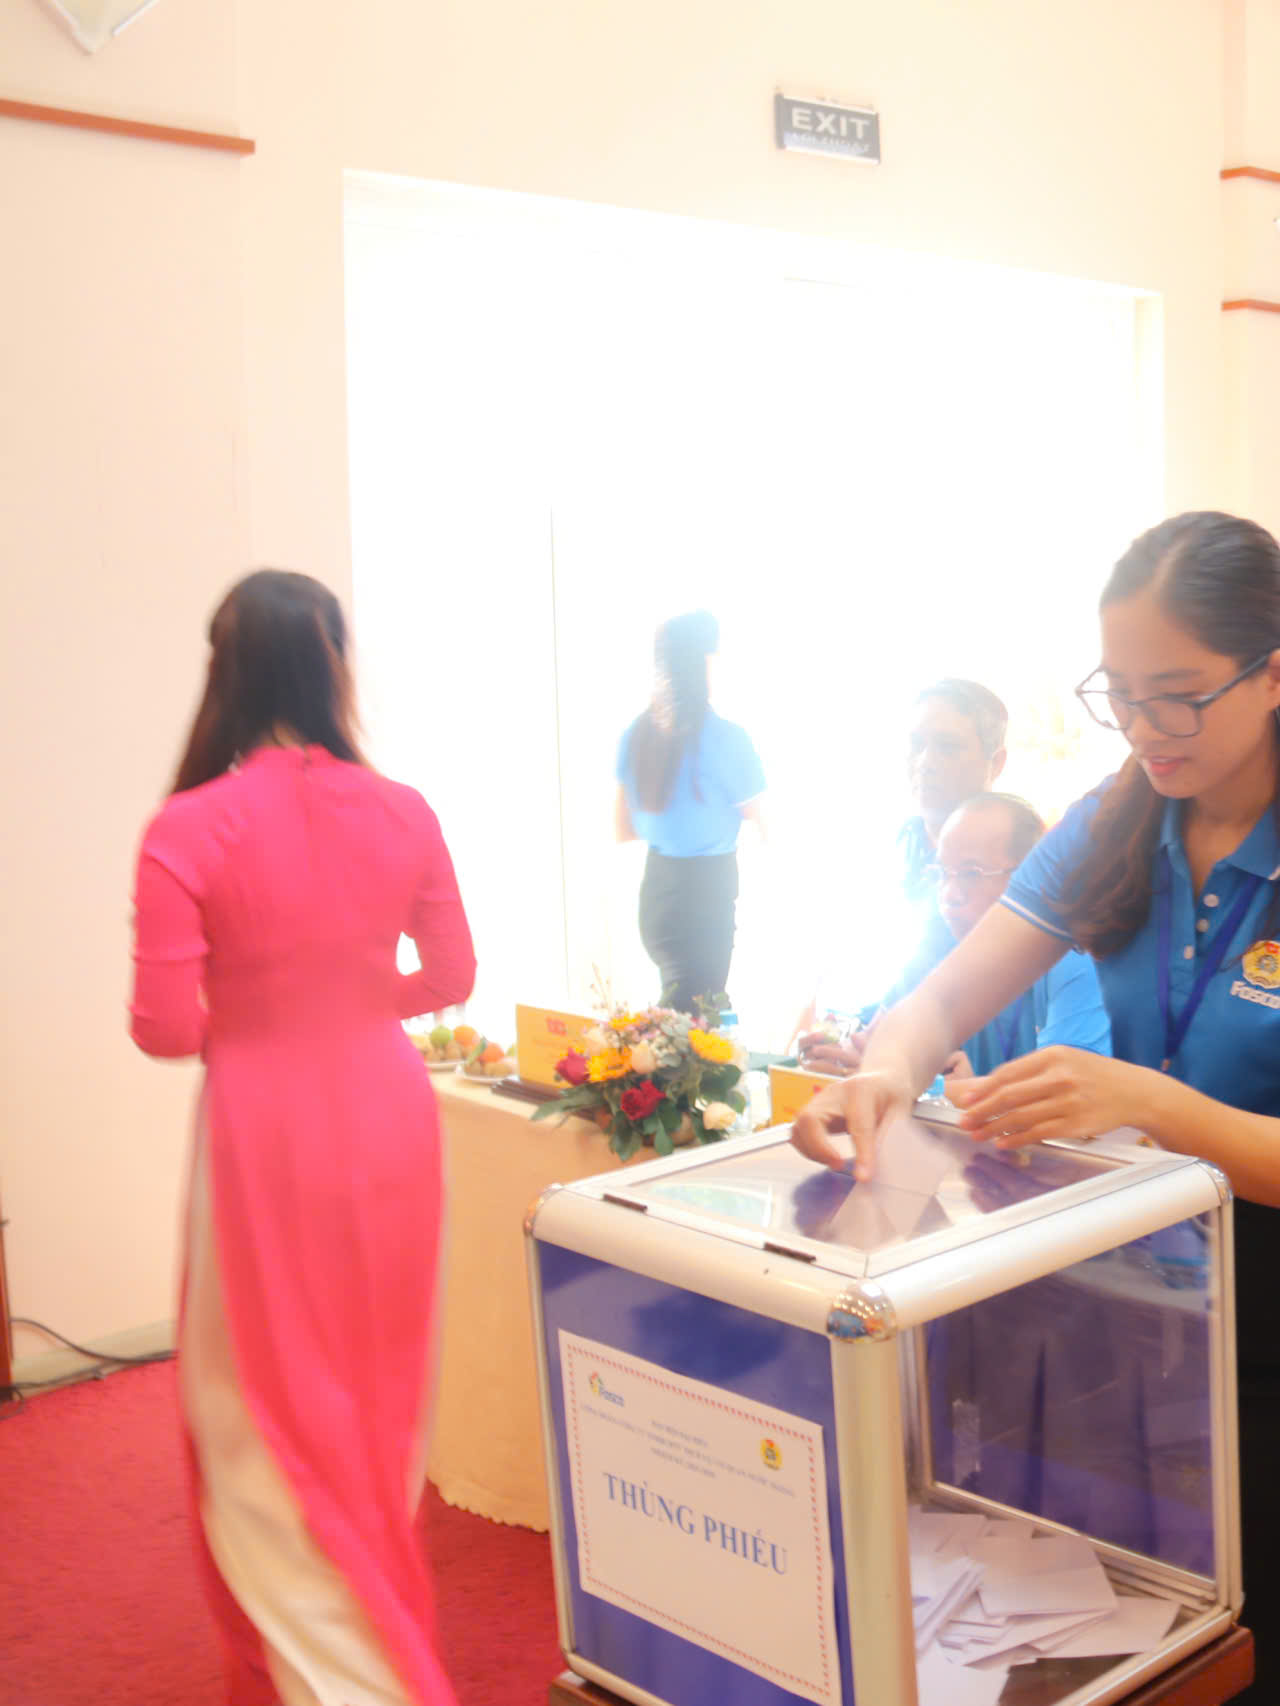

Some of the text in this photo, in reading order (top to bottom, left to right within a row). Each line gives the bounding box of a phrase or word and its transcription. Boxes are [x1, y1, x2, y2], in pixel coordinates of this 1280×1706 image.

[791, 106, 871, 139] EXIT
[602, 1472, 696, 1536] THÙNG
[702, 1513, 788, 1576] PHIẾU
